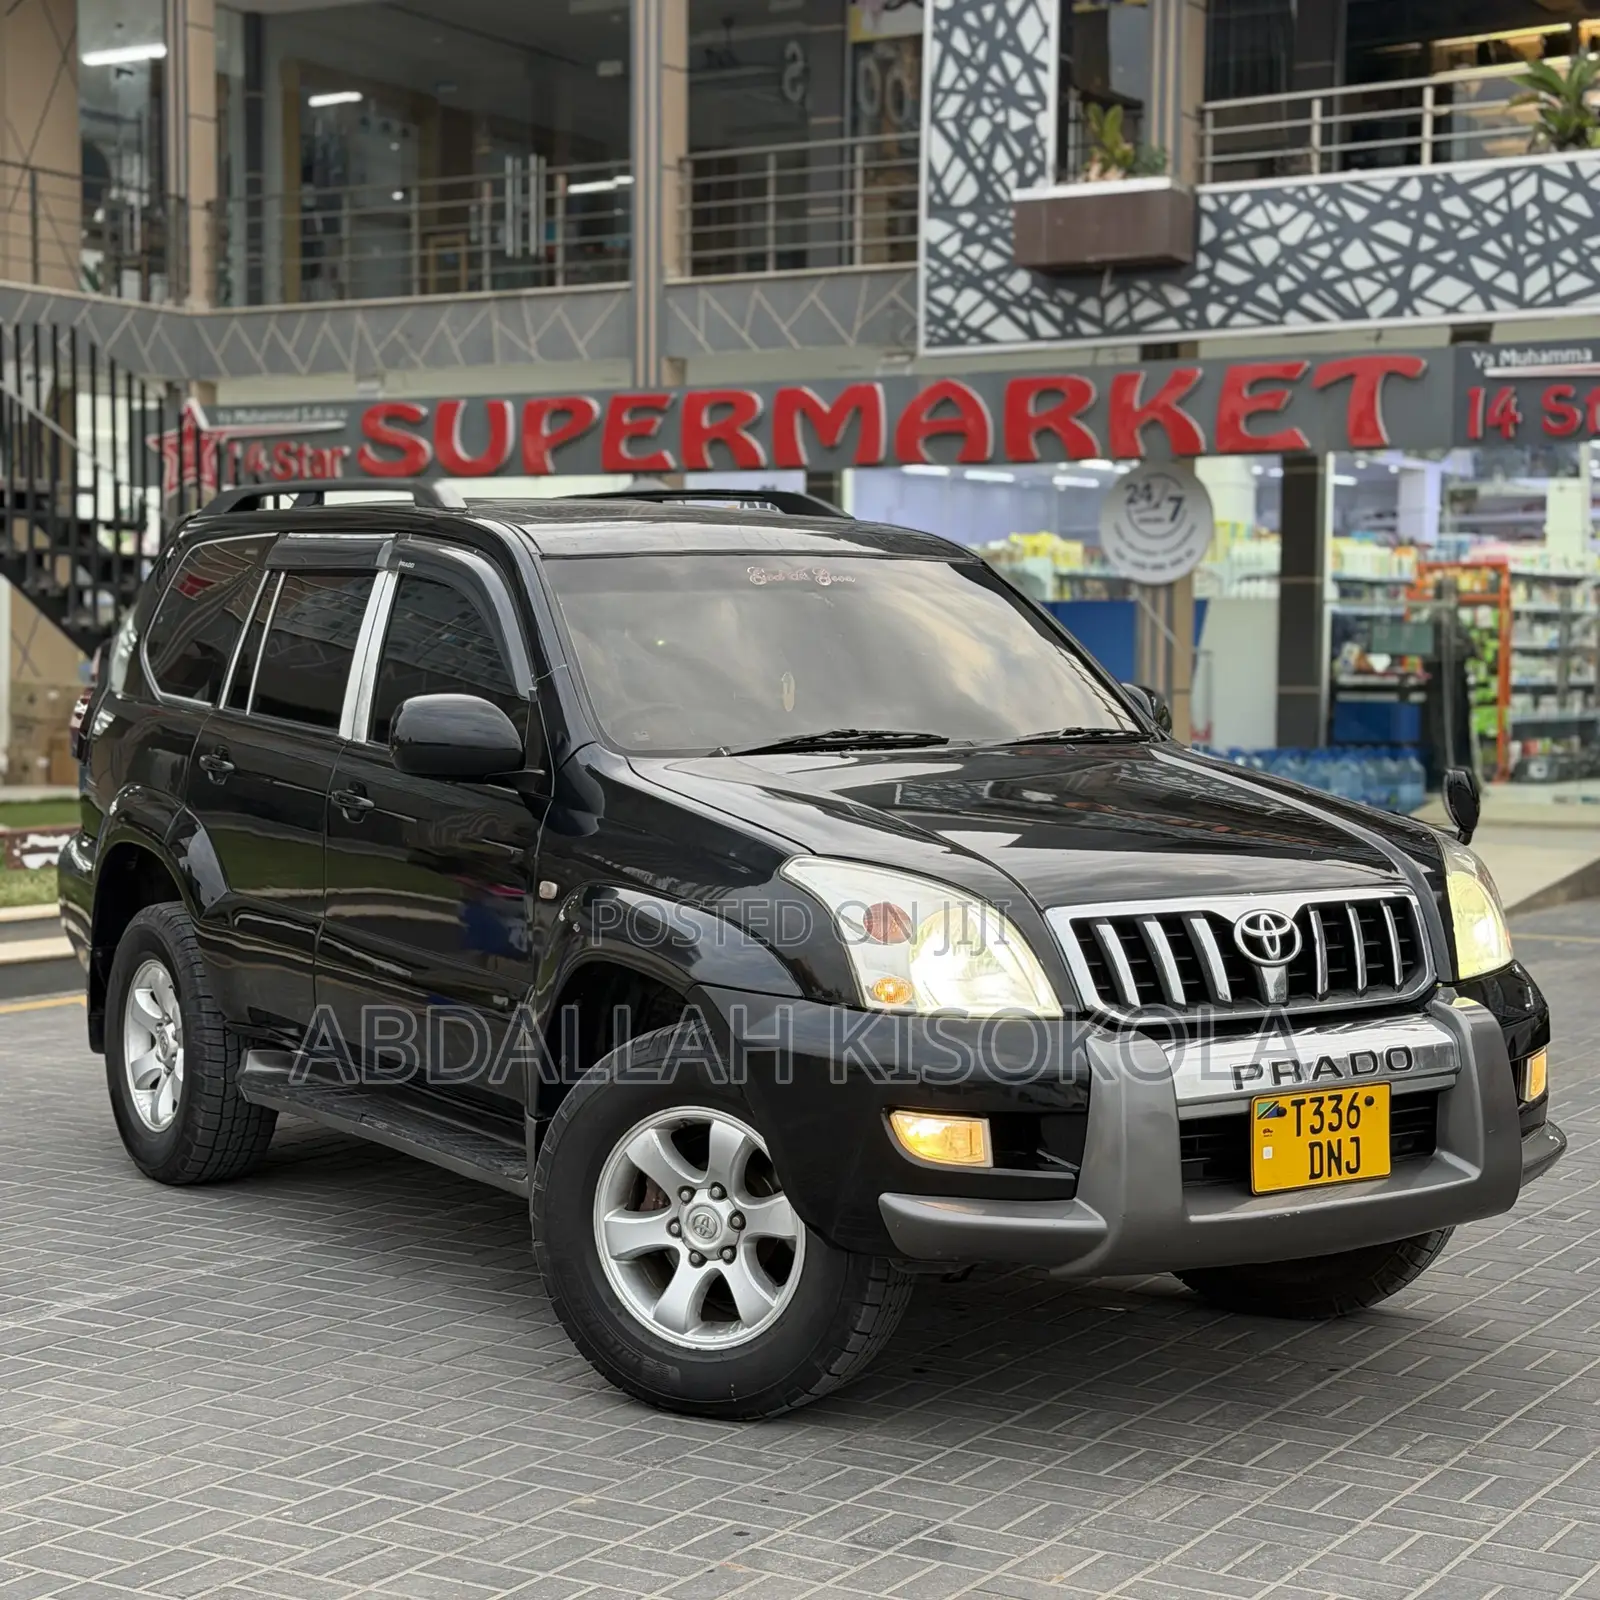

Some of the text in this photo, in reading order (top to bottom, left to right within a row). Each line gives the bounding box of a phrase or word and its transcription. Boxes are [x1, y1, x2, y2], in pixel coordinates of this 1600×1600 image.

[1471, 350, 1496, 368] Ya
[358, 356, 1427, 477] SUPERMARKET
[1466, 385, 1523, 439] 14
[270, 440, 350, 481] Star
[1125, 482, 1186, 523] 24/7
[1230, 1045, 1414, 1091] PRADO
[1290, 1091, 1362, 1137] T336
[1308, 1136, 1361, 1180] DNJ
